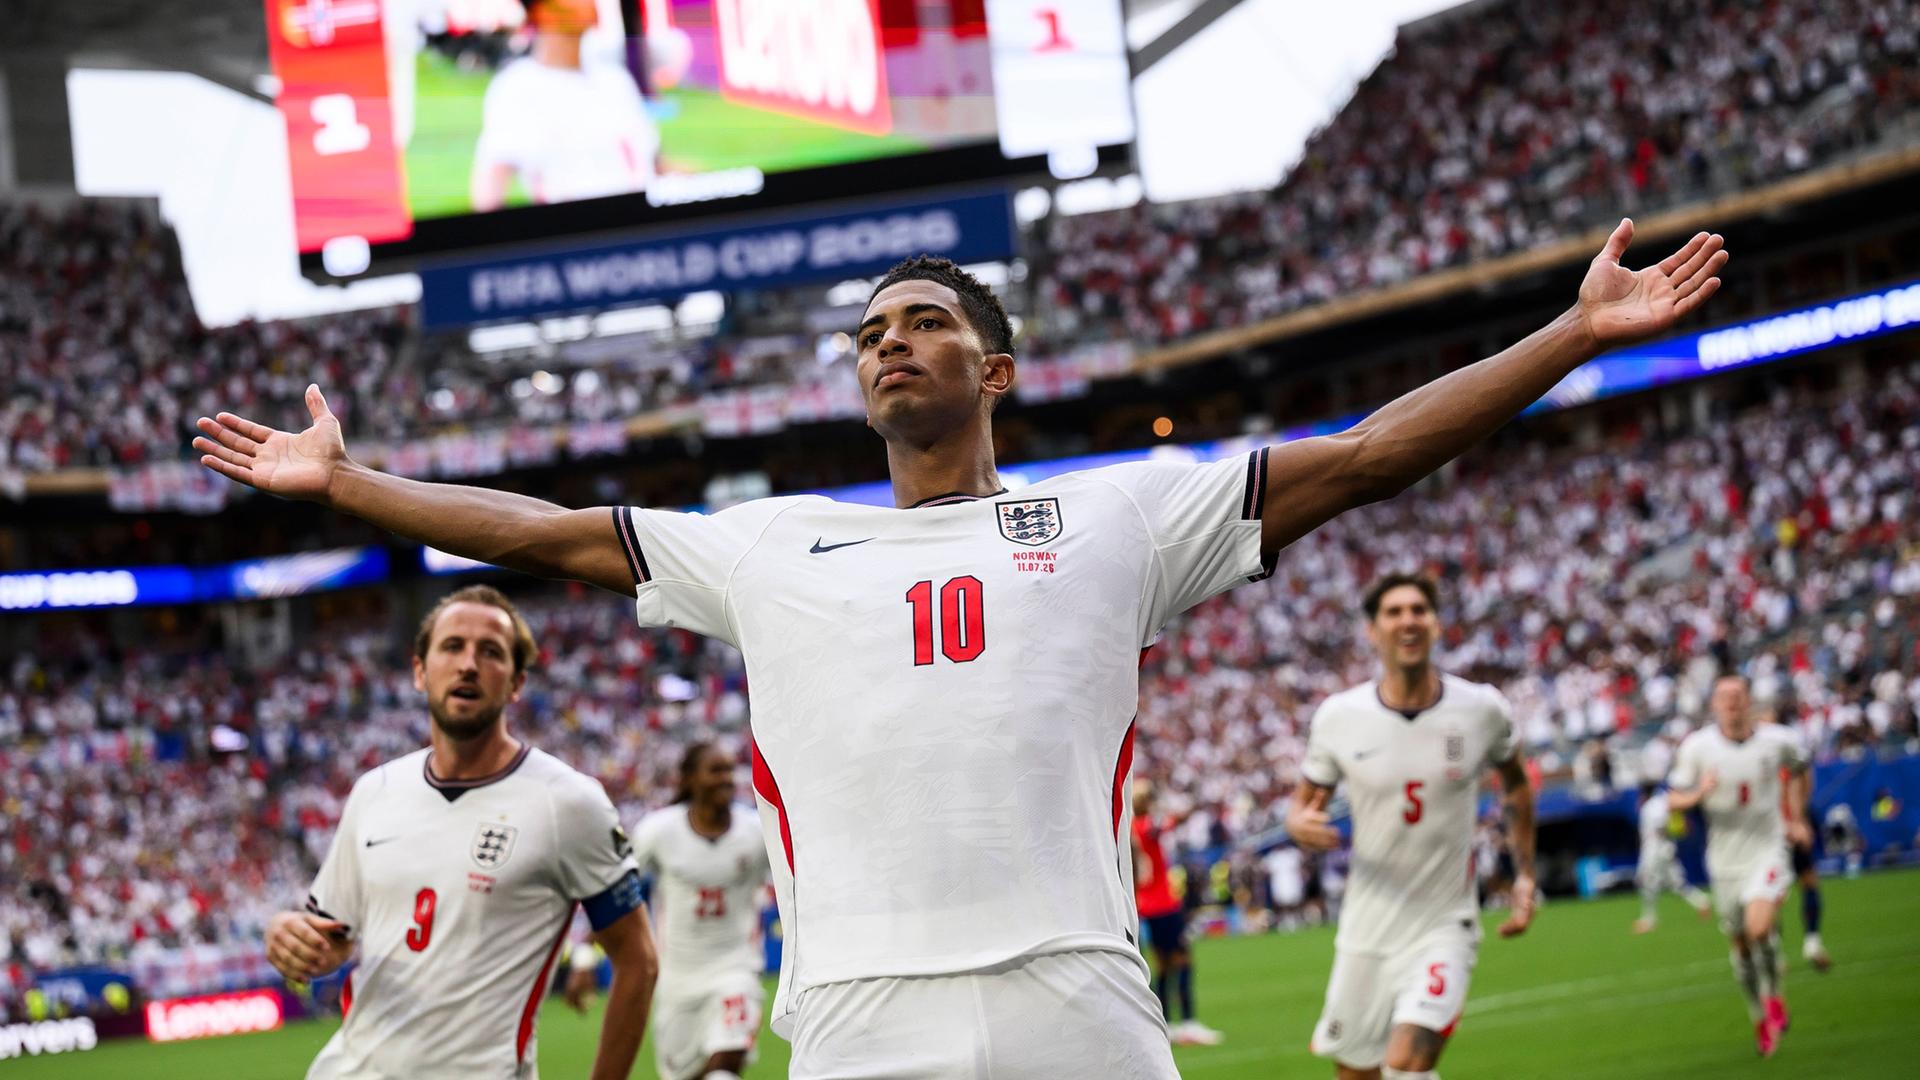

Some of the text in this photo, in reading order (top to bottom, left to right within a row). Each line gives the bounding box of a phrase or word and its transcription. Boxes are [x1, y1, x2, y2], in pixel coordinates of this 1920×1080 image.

[1032, 7, 1076, 55] 1
[470, 208, 961, 312] FIFA WORLD CUP 2026
[1013, 551, 1057, 561] NORWAY
[1017, 562, 1055, 573] 11.07.26
[906, 575, 986, 666] 10
[1402, 780, 1425, 826] 5
[406, 887, 437, 952] 9
[1427, 962, 1447, 997] 5
[148, 995, 281, 1042] Lenovo
